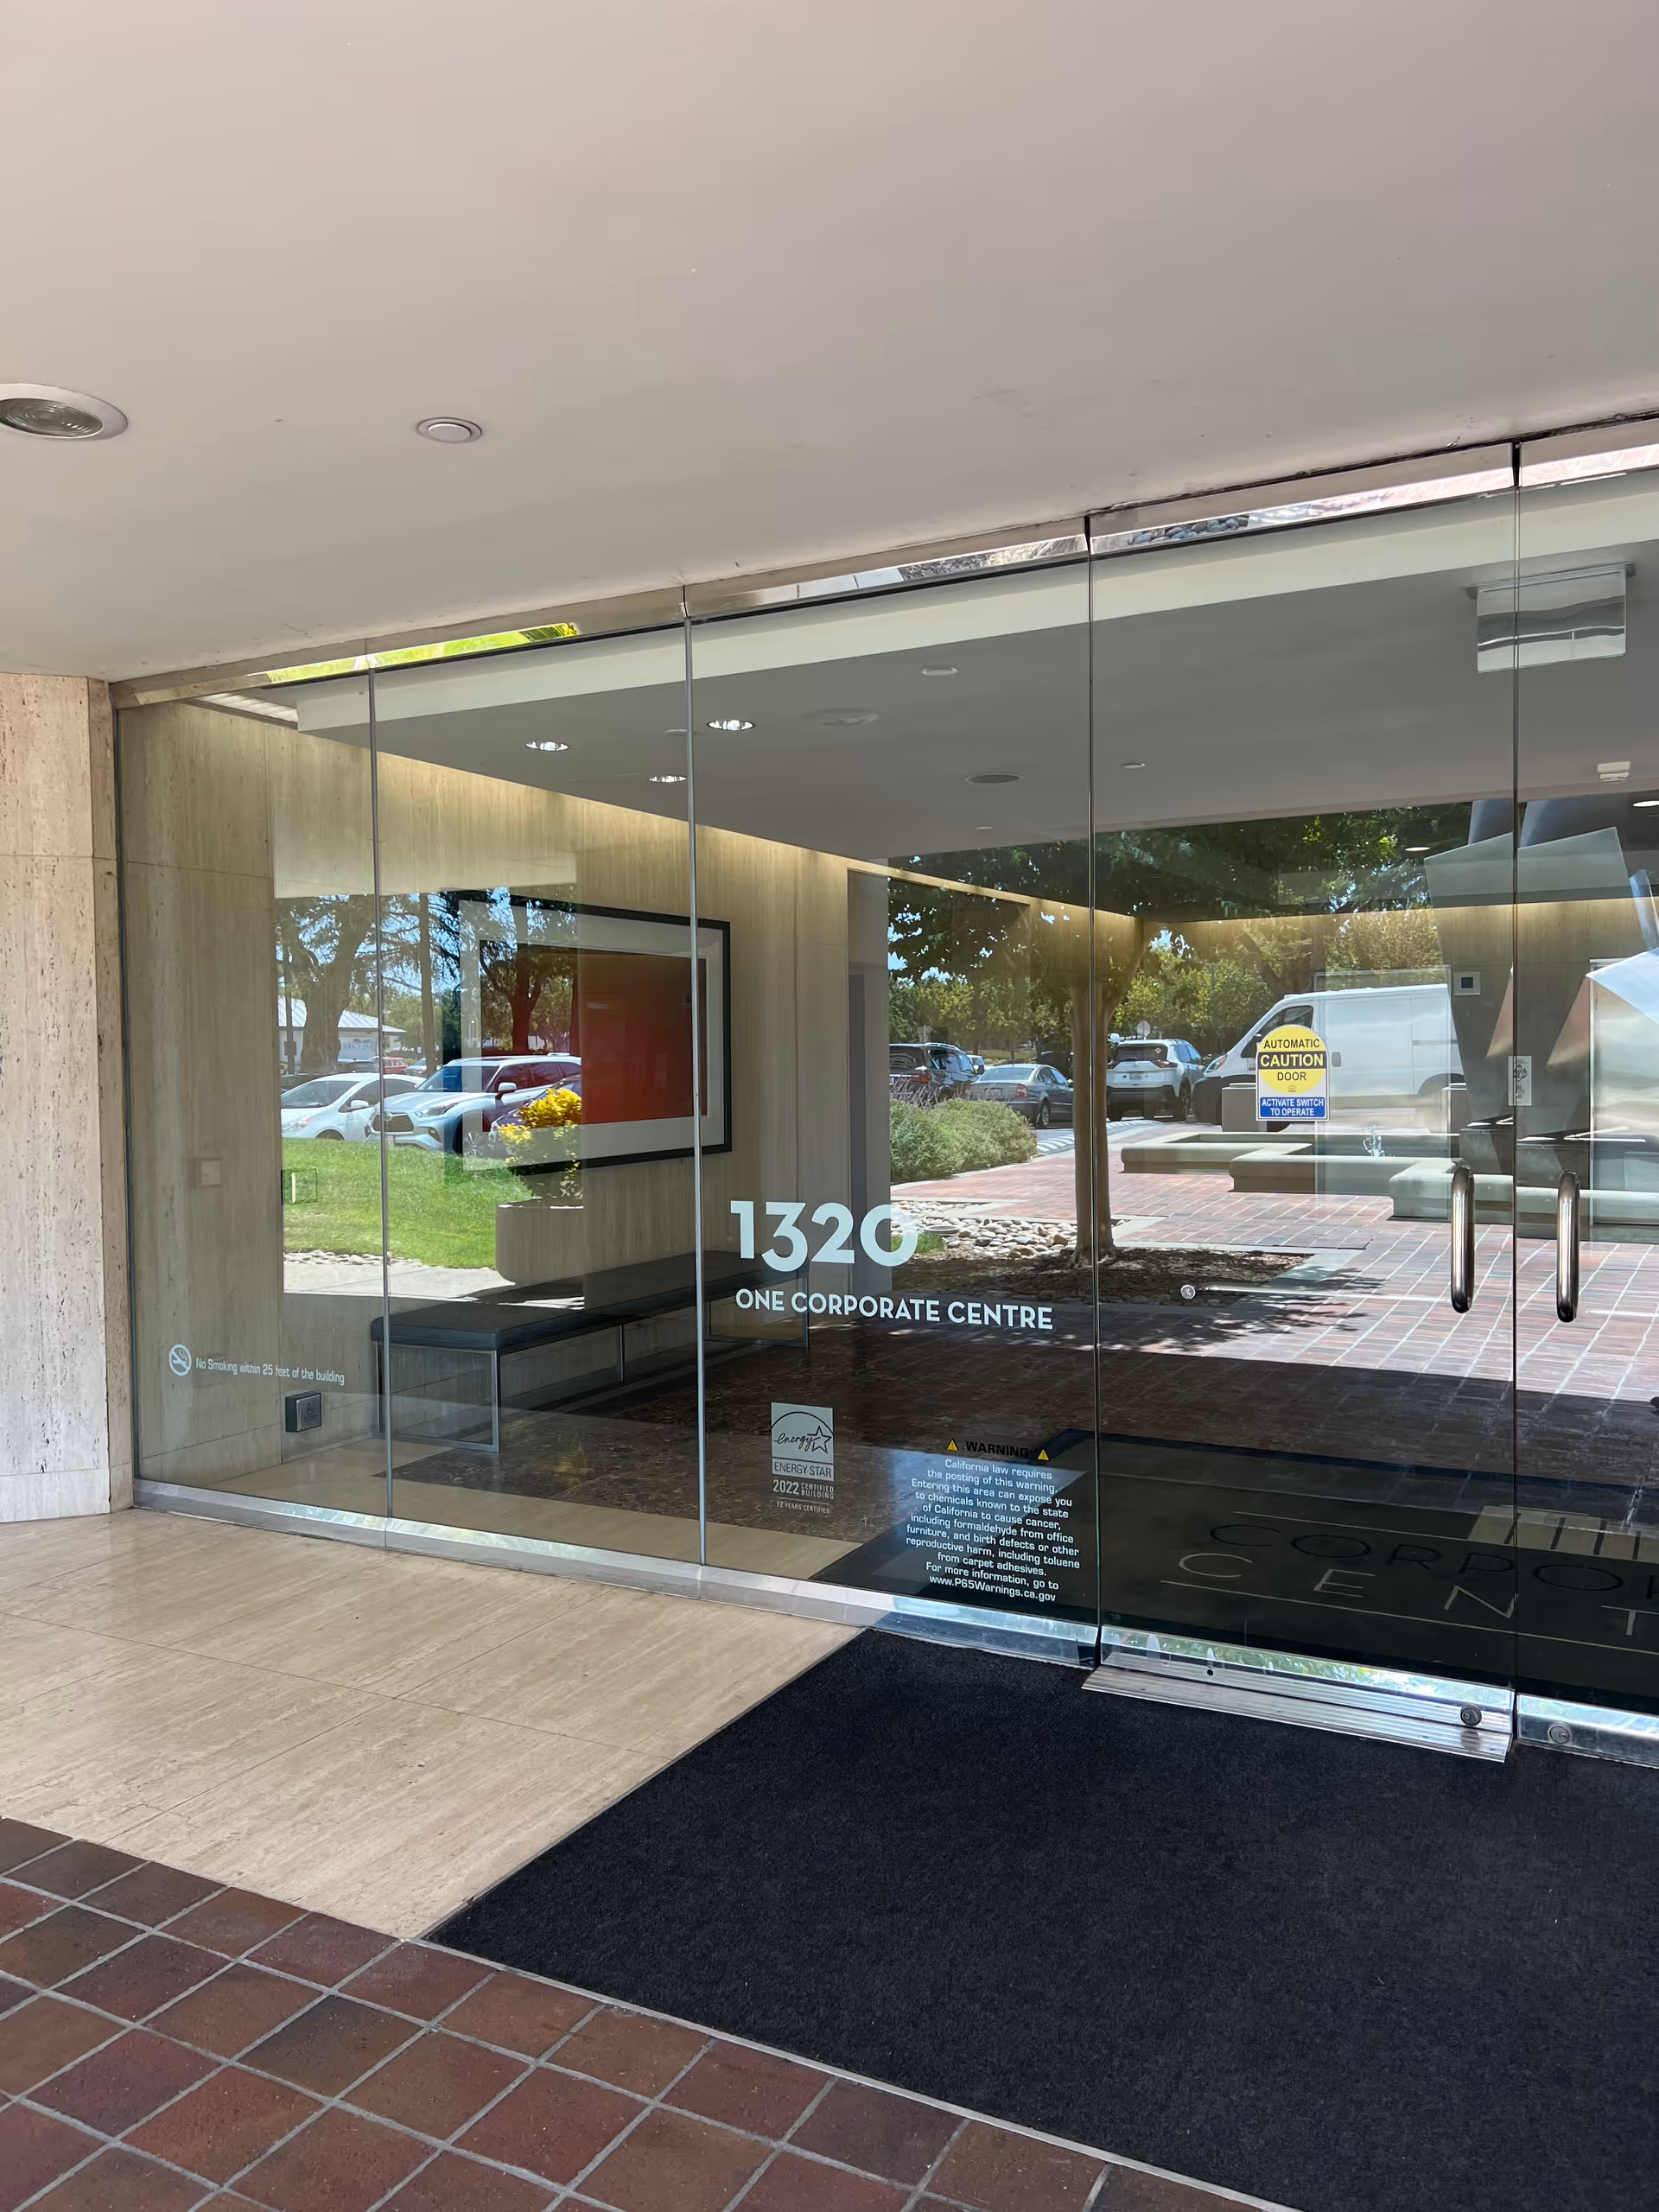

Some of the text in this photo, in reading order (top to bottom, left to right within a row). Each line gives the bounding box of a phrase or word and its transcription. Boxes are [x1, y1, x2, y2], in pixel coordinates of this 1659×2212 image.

[1264, 1039, 1319, 1048] AUTOMATIC
[1261, 1054, 1323, 1067] CAUTION
[731, 1200, 918, 1272] 1320
[735, 1288, 1053, 1330] ONE CORPORATE CENTRE
[196, 1357, 345, 1386] No Smoking within 25 feet of the building
[773, 1433, 817, 1452] energy
[966, 1440, 1029, 1457] WARNING
[774, 1462, 831, 1478] ENERGY STAR
[927, 1470, 942, 1478] the
[945, 1472, 979, 1484] posting
[995, 1478, 1013, 1487] this
[1016, 1481, 1058, 1494] warning.
[945, 1459, 1052, 1480] California law requires
[773, 1479, 834, 1495] 2022 CERTIFIED
[801, 1490, 834, 1499] BUILDING
[912, 1478, 950, 1493] Entering
[952, 1484, 969, 1493] this
[1019, 1494, 1052, 1504] expose
[1055, 1497, 1072, 1507] you
[803, 1505, 830, 1514] CERTIFIED
[915, 1491, 1068, 1518] to chemicals known to the state
[911, 1513, 1074, 1543] including formaldehyde from office
[935, 1505, 978, 1518] California
[982, 1511, 991, 1520] to
[995, 1514, 1022, 1524] cause
[1026, 1518, 1061, 1531] cancer,
[906, 1524, 950, 1540] furniture,
[954, 1531, 970, 1541] and
[974, 1534, 995, 1545] birth
[1000, 1537, 1034, 1550] defects
[1052, 1546, 1079, 1556] other
[906, 1537, 1080, 1568] reproductive harm, including toluene
[938, 1552, 1046, 1576] from carpet adhesives.
[1210, 1524, 1659, 1599] CORPO
[926, 1561, 1058, 1590] For more information, go to
[930, 1575, 1056, 1602] www.P65Warnings.ca.gov
